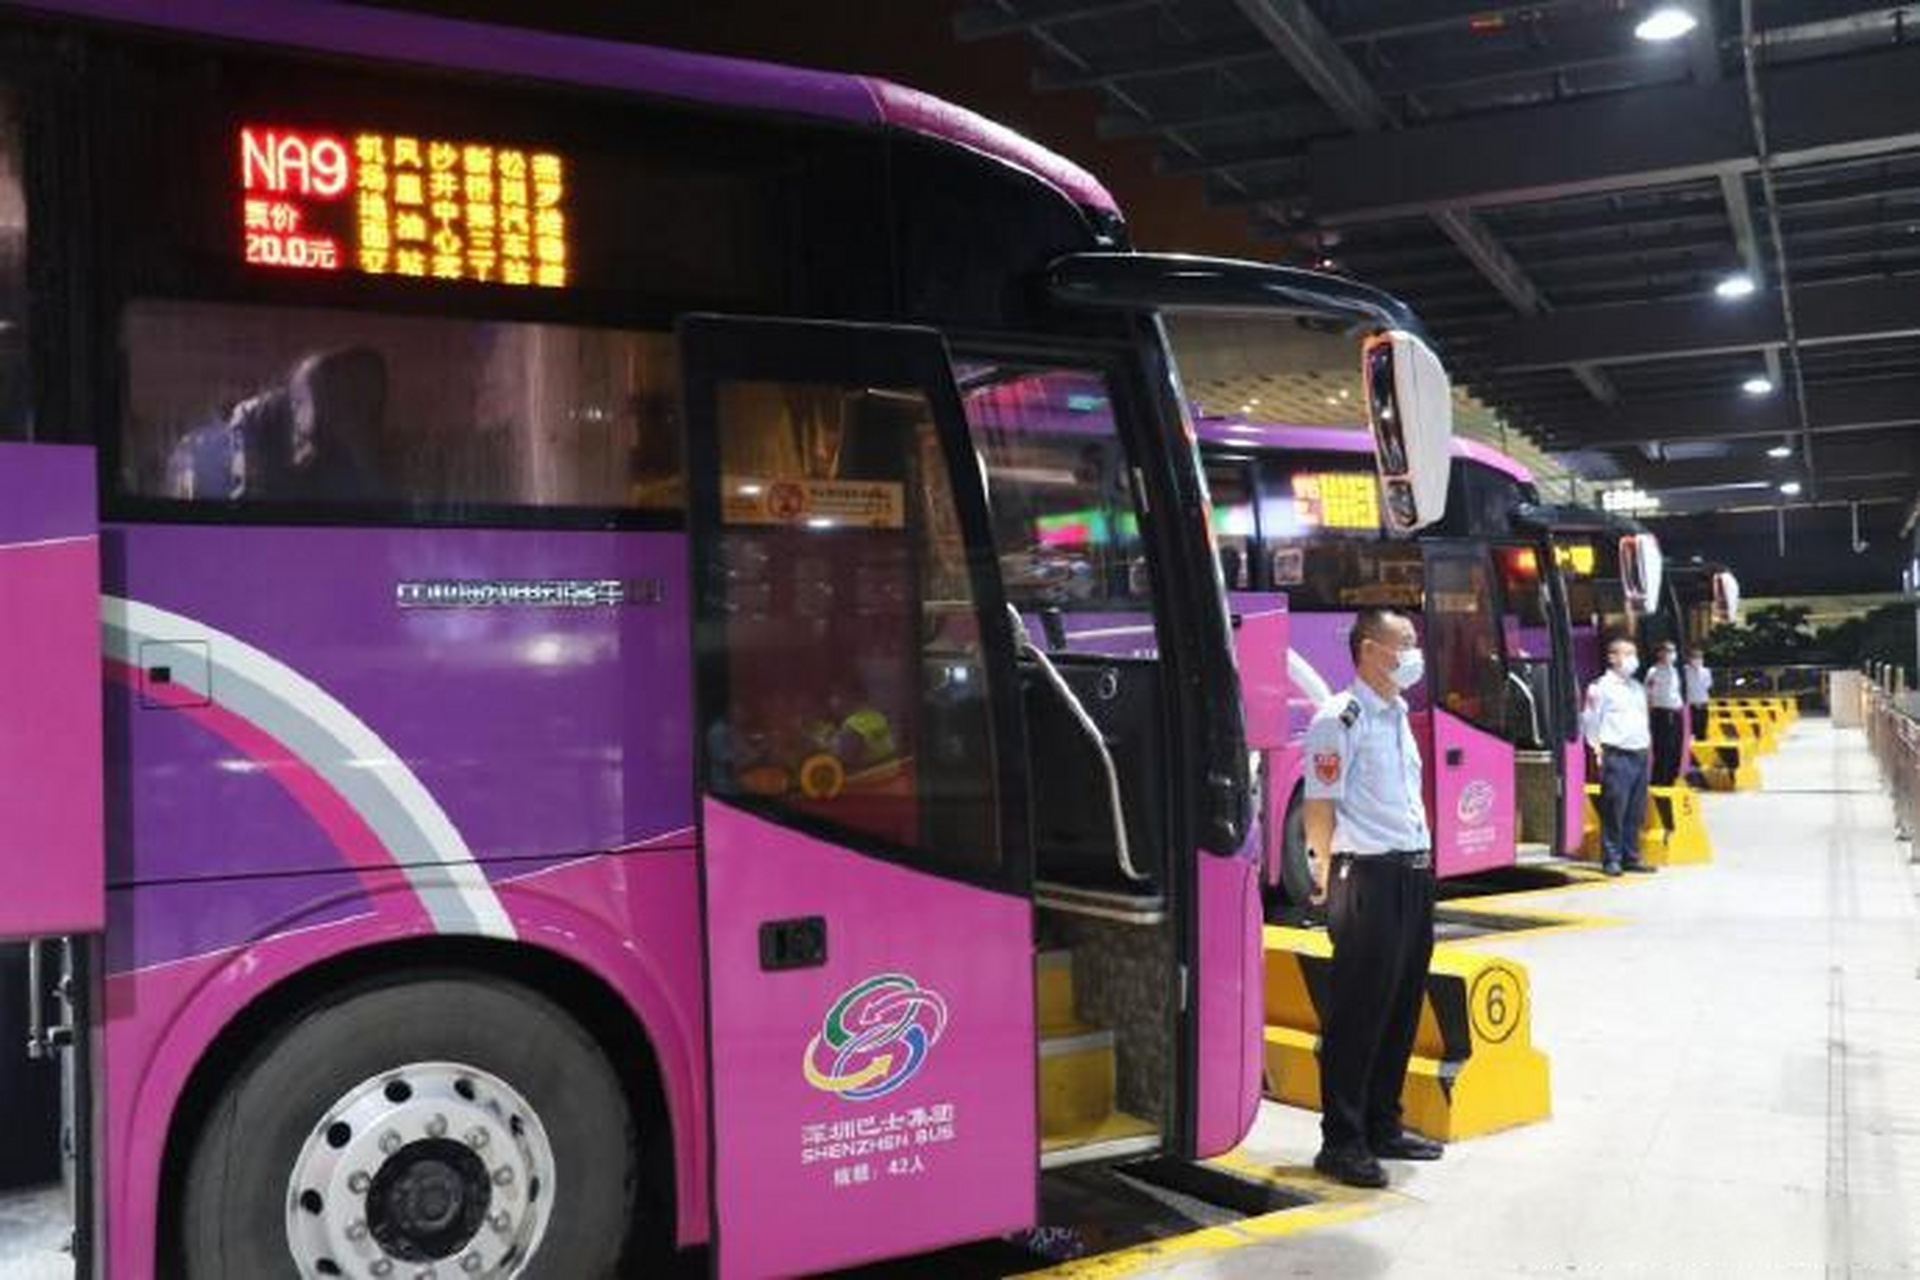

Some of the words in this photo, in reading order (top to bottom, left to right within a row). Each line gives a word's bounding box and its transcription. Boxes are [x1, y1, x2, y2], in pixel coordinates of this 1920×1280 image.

[241, 128, 348, 194] NA9
[245, 200, 298, 231] 票价
[246, 234, 336, 268] 20.0元
[1486, 984, 1506, 1024] 6
[801, 1134, 909, 1165] SHENZHEN
[915, 1126, 956, 1146] BUS
